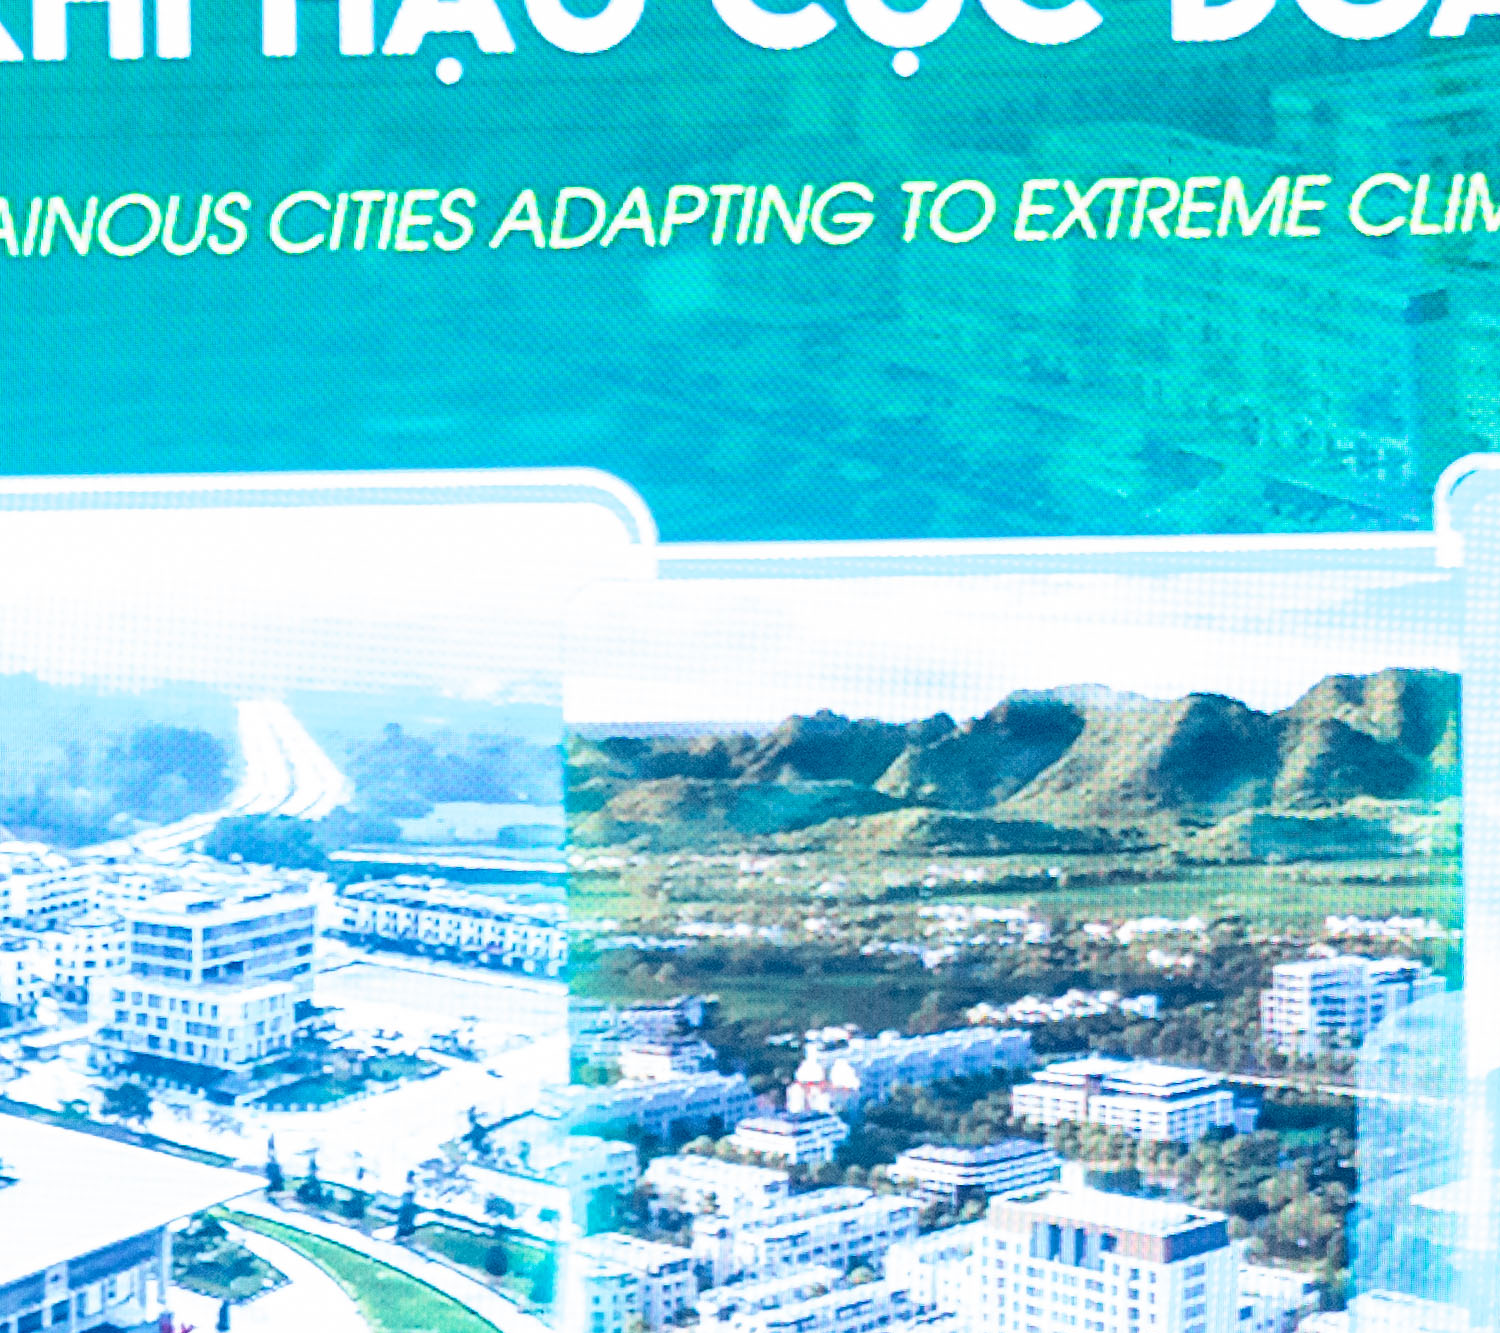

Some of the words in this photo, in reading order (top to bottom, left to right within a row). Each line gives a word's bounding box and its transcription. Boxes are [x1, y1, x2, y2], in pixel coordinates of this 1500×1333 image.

[269, 187, 477, 254] CITIES
[488, 181, 875, 250] ADAPTING
[900, 179, 996, 244] TO
[1012, 174, 1332, 241] EXTREME
